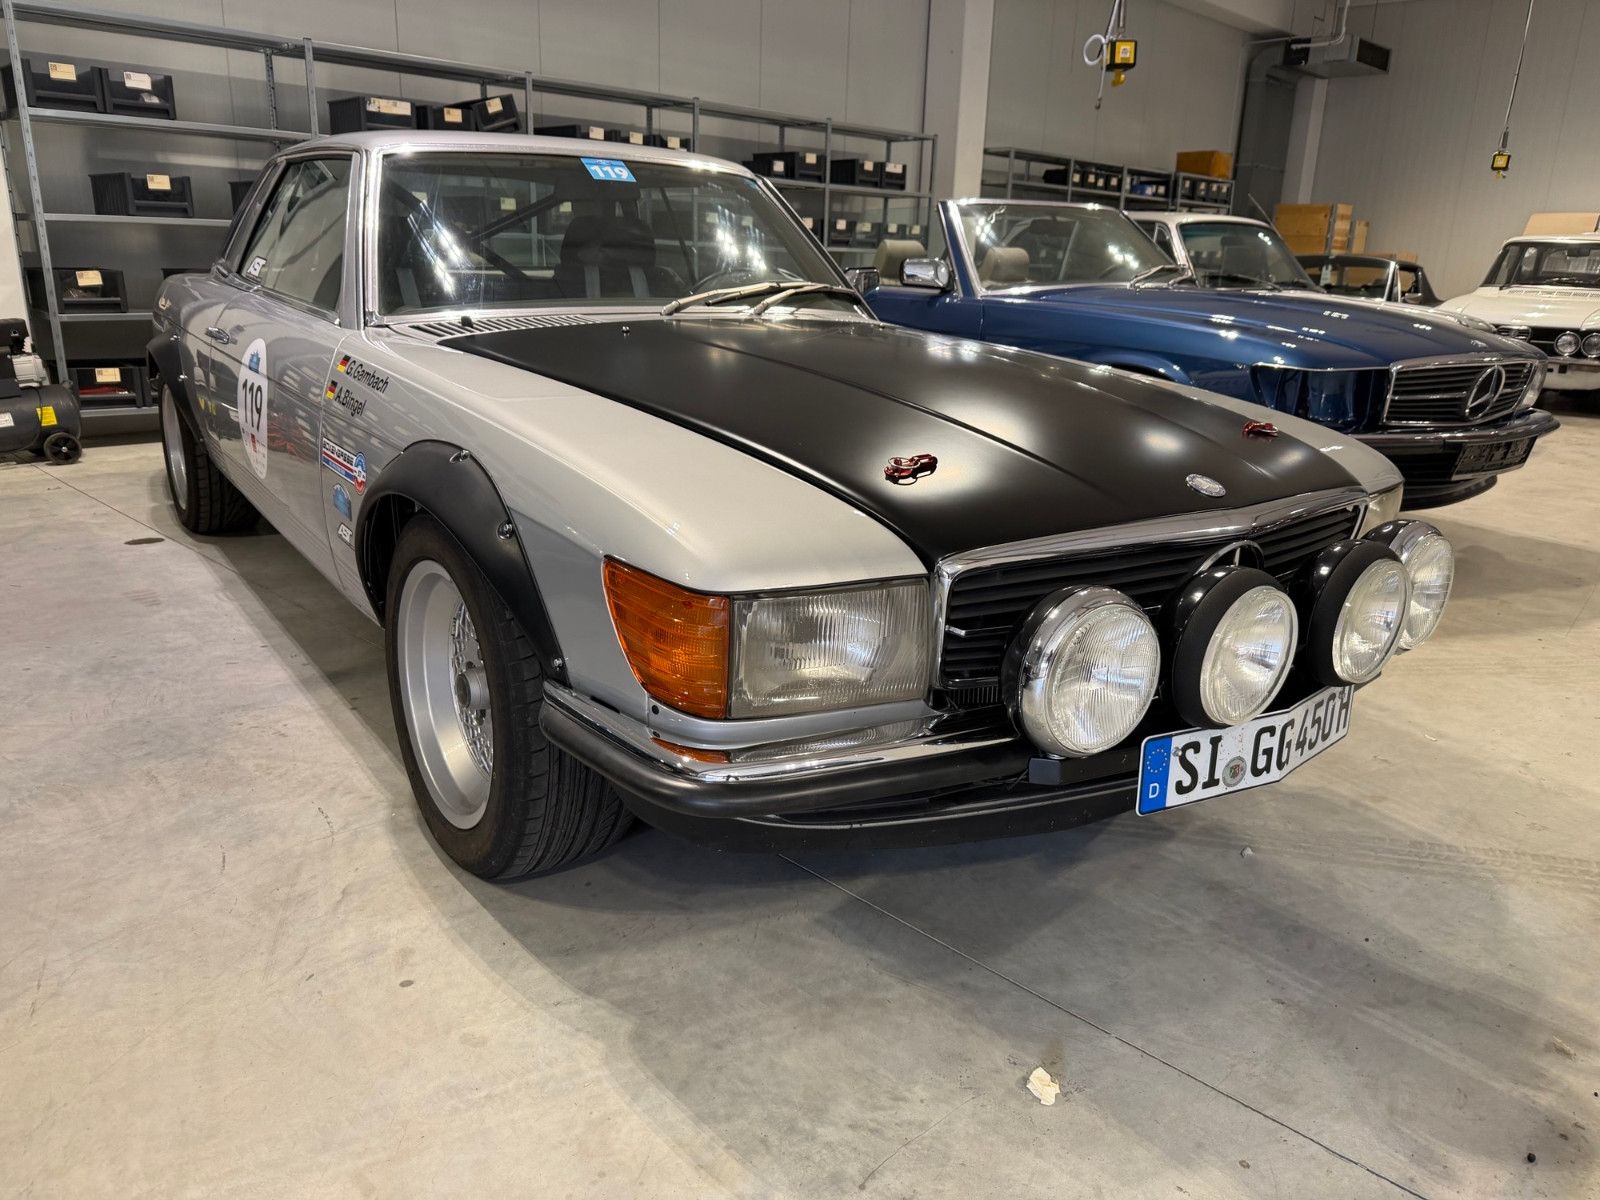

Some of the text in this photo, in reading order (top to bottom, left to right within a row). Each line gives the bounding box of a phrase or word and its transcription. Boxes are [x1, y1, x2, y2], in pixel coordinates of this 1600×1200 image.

[591, 165, 629, 179] 119
[242, 379, 263, 432] 119
[1174, 735, 1222, 795] SI
[1148, 783, 1160, 799] D
